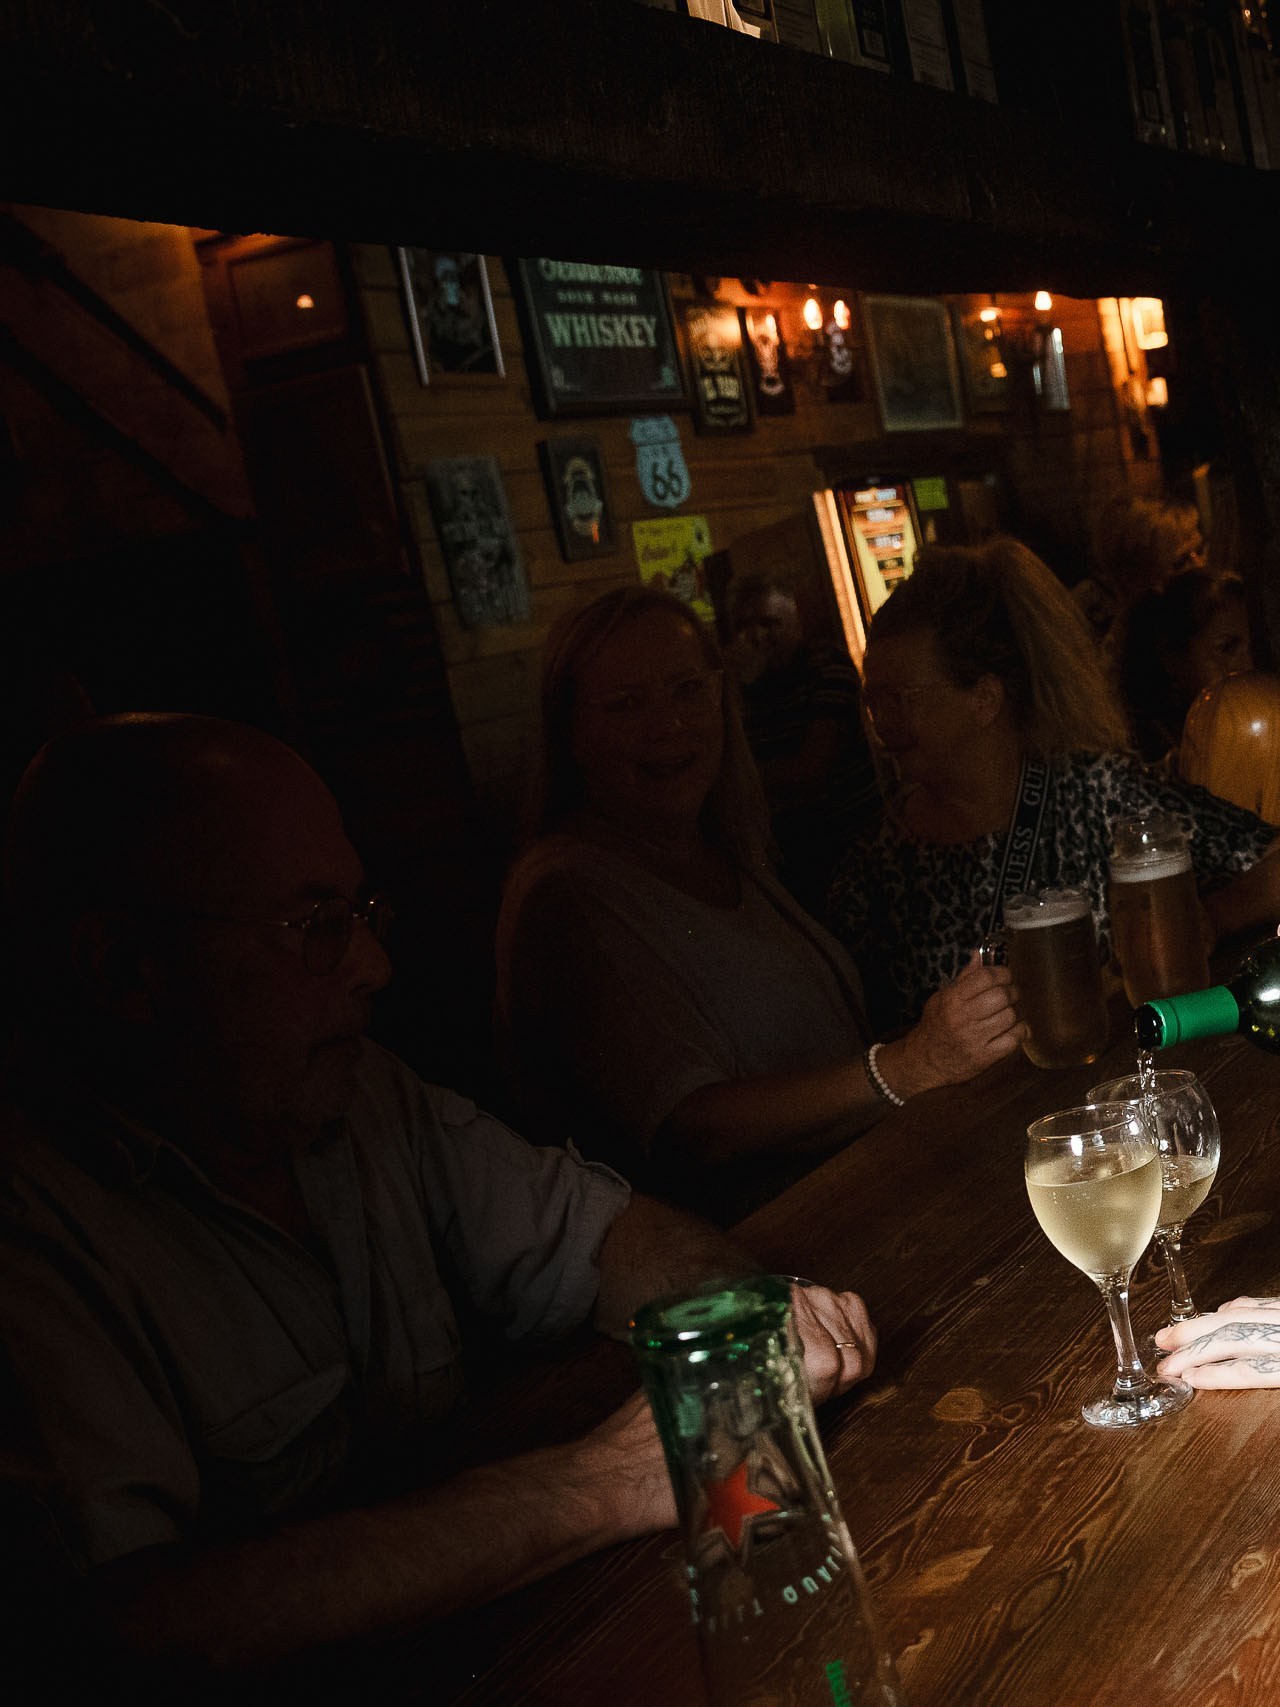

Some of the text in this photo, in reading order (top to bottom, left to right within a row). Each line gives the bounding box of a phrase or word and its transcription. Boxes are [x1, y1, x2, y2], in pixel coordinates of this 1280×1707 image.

[545, 313, 656, 348] WHISKEY
[653, 460, 681, 500] 66
[1003, 754, 1048, 897] GUESS GUE
